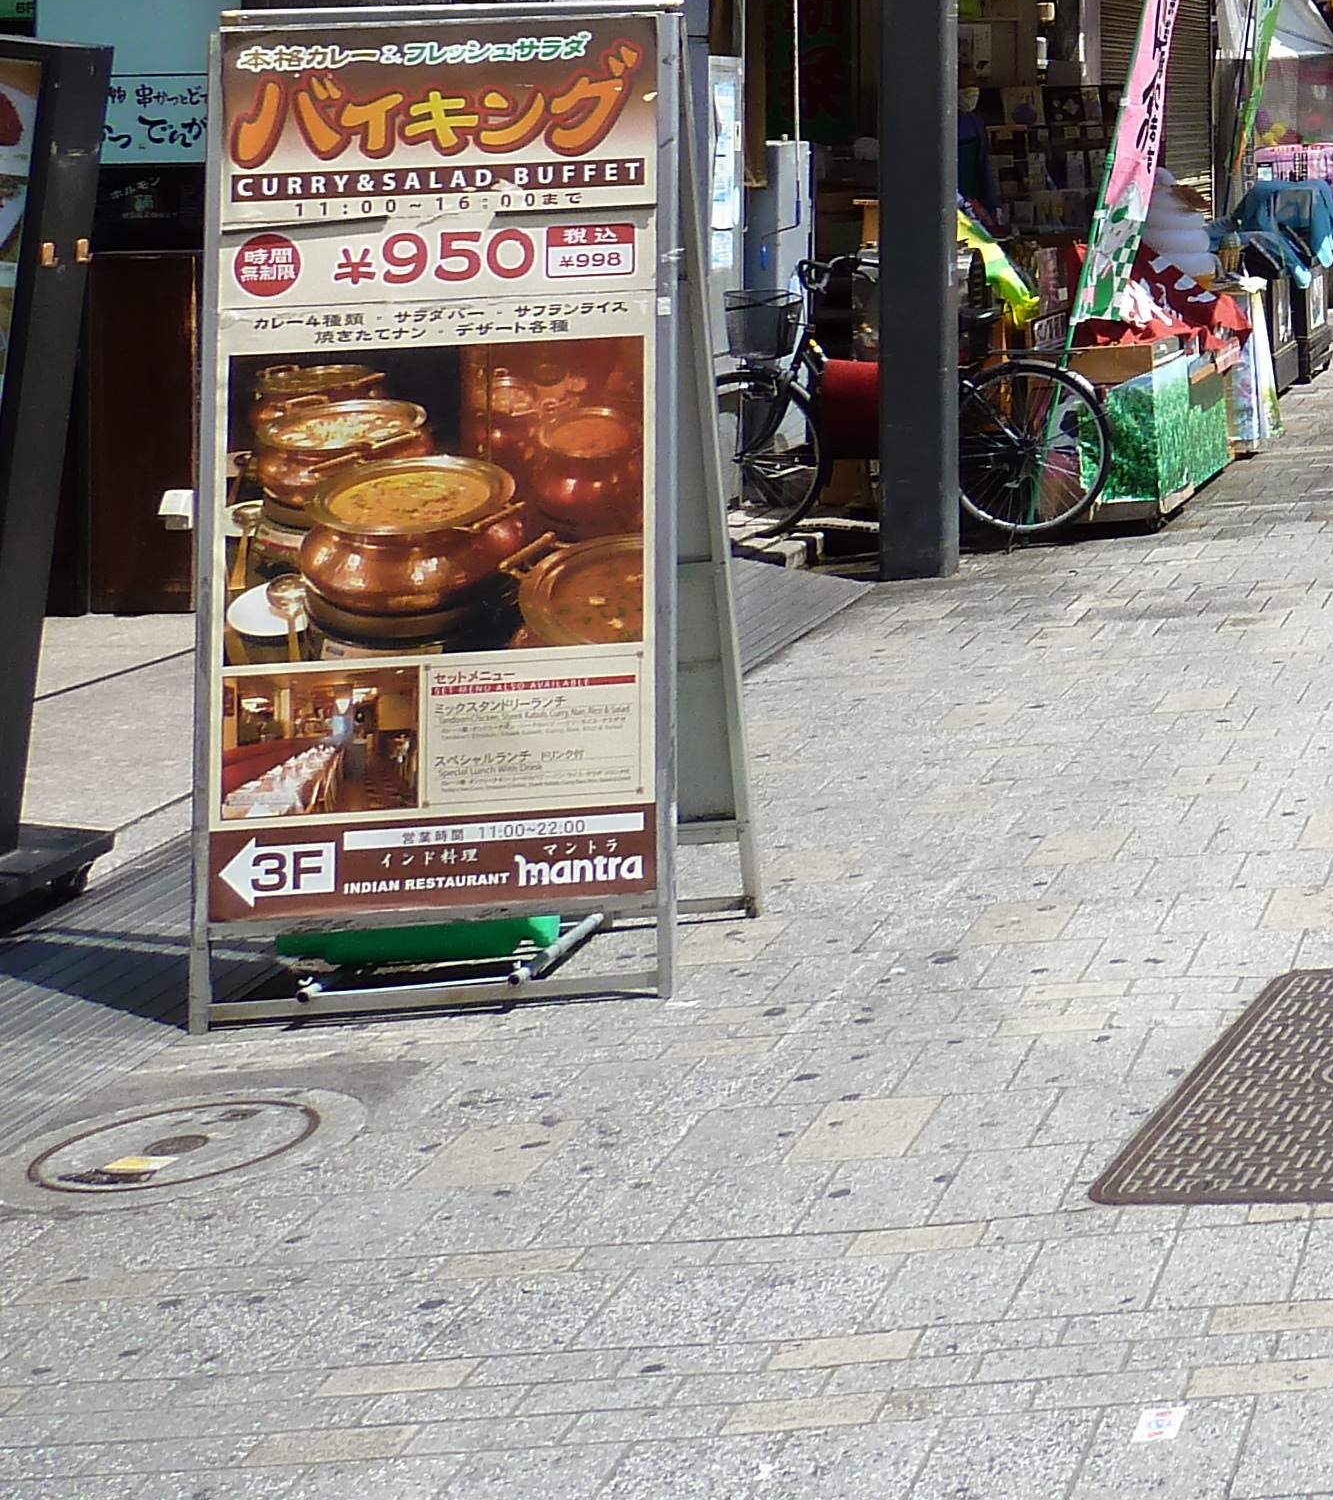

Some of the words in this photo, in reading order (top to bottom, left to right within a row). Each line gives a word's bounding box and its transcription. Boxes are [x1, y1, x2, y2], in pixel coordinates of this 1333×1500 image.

[232, 42, 643, 168] バイキング
[237, 169, 493, 196] CURRY&SALAD
[514, 162, 641, 186] BUFFET
[562, 228, 619, 244] 税込
[244, 248, 293, 264] 時間
[333, 228, 536, 286] ¥950
[558, 251, 623, 269] ¥998
[240, 264, 296, 282] 無制限
[434, 670, 516, 685] セットメニュー
[458, 684, 492, 694] MENU
[496, 681, 526, 692] ALSO
[530, 678, 591, 690] AVAILABLE
[435, 750, 532, 768] スペシャルランチ
[438, 765, 468, 777] Special
[470, 764, 497, 775] Lunch
[401, 829, 465, 845] 営業時間
[543, 838, 619, 856] マントラ
[380, 848, 480, 867] インド料理
[251, 850, 323, 893] 3F
[514, 854, 644, 887] mantra
[343, 877, 399, 894] INDIAN
[404, 872, 510, 891] RESTAURANT
